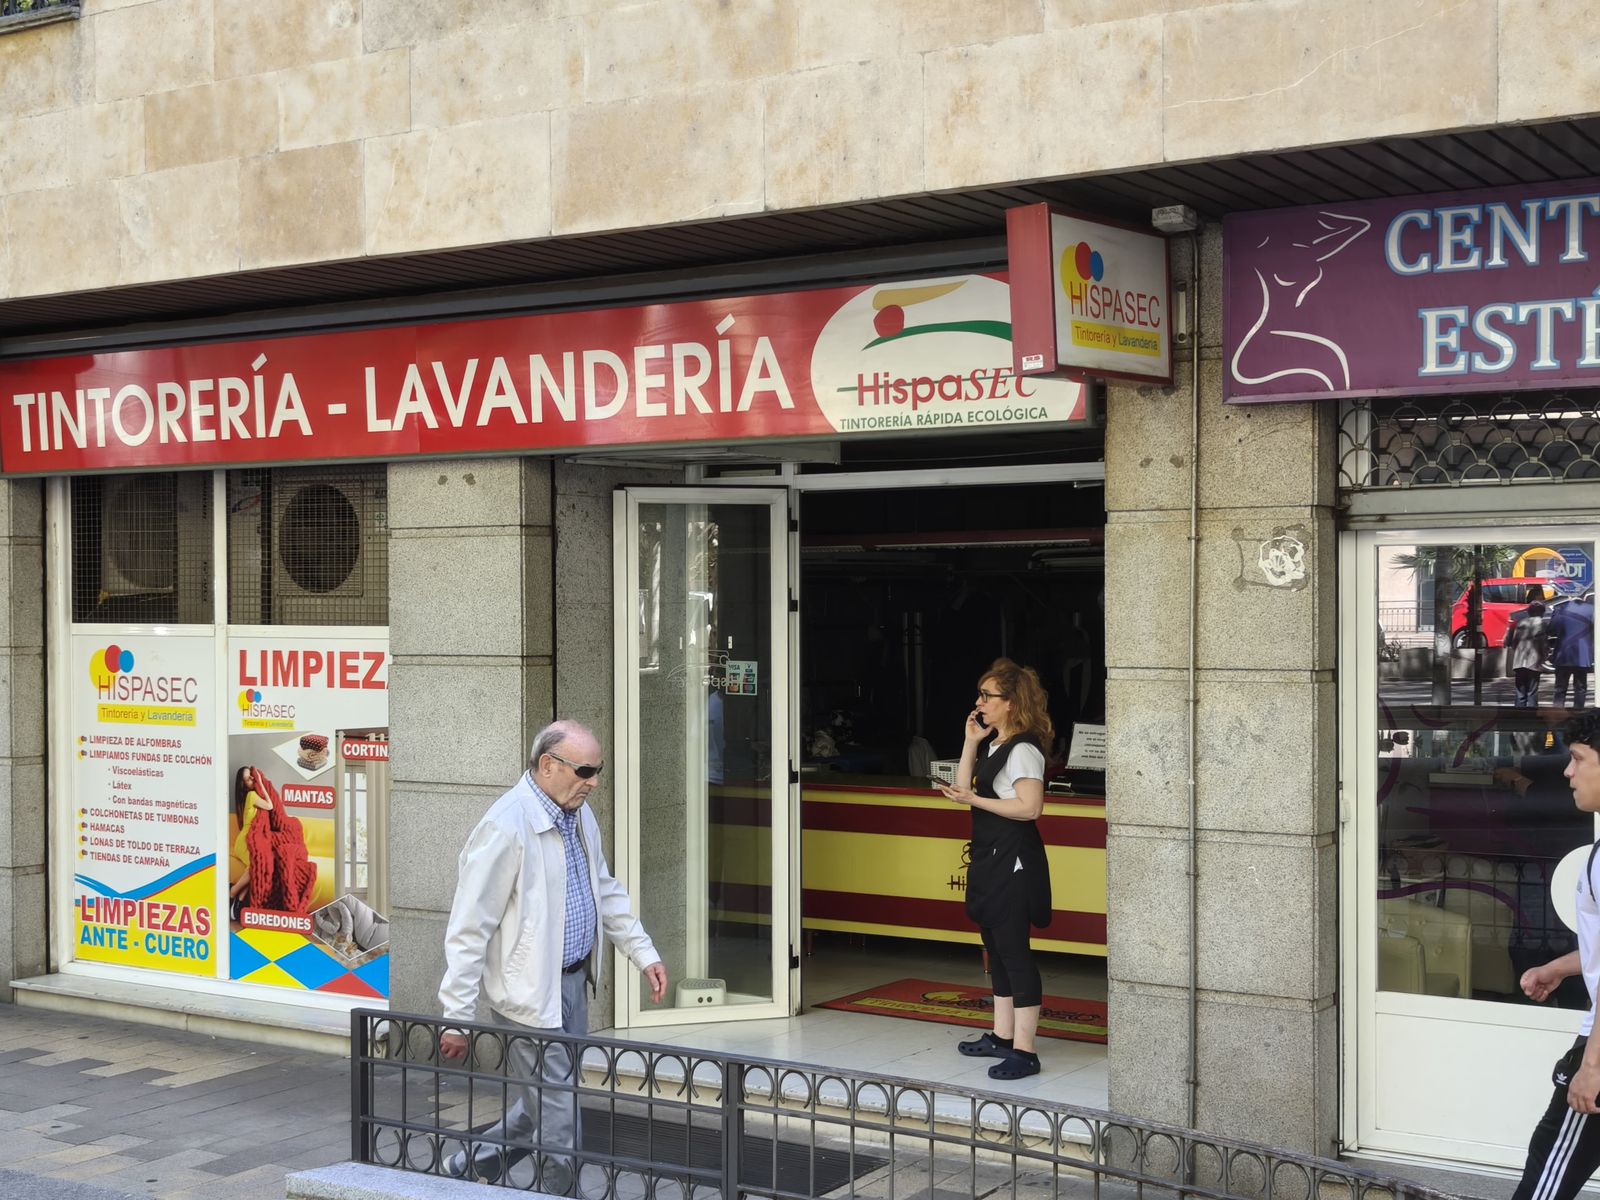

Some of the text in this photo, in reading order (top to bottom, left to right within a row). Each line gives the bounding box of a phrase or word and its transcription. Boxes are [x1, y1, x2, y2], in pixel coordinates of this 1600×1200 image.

[1385, 193, 1600, 276] CENT
[1070, 281, 1160, 328] HISPASEC
[1075, 326, 1111, 343] Tintorería
[1112, 335, 1117, 347] y
[14, 352, 313, 452] TINTORERÍA
[364, 313, 795, 433] LAVANDERÍA
[840, 405, 1048, 430] TINTORERÍA RÁPIDA ECOLÓGICA
[1556, 562, 1586, 577] ADT
[239, 650, 388, 689] LIMPIEZ
[98, 675, 198, 703] HISPASEC
[102, 707, 193, 721] Tintorería y Lavandería
[242, 703, 296, 719] HISPASEC
[89, 735, 182, 748] LIMPIEZA DE ALFOMBRAS
[89, 750, 212, 765] LIMPIAMOS FUNDAS DE COLCHÓN
[343, 743, 389, 757] CORTIN
[112, 766, 164, 777] Viscoelásticas
[112, 781, 132, 790] Látex
[112, 795, 198, 810] Con bandas magnéticas
[284, 789, 334, 804] MANTAS
[90, 808, 199, 825] COLCHONETAS DE TUMBONAS
[90, 823, 125, 833] HAMACAS
[90, 837, 200, 855] LONAS DE TOLDO DE TERRAZA
[90, 851, 170, 867] TIENDAS DE CAMPAÑA
[81, 895, 211, 936] LIMPIEZAS
[244, 912, 311, 931] EDREDONES
[80, 925, 129, 950] ANTE
[145, 933, 209, 961] CUERO
